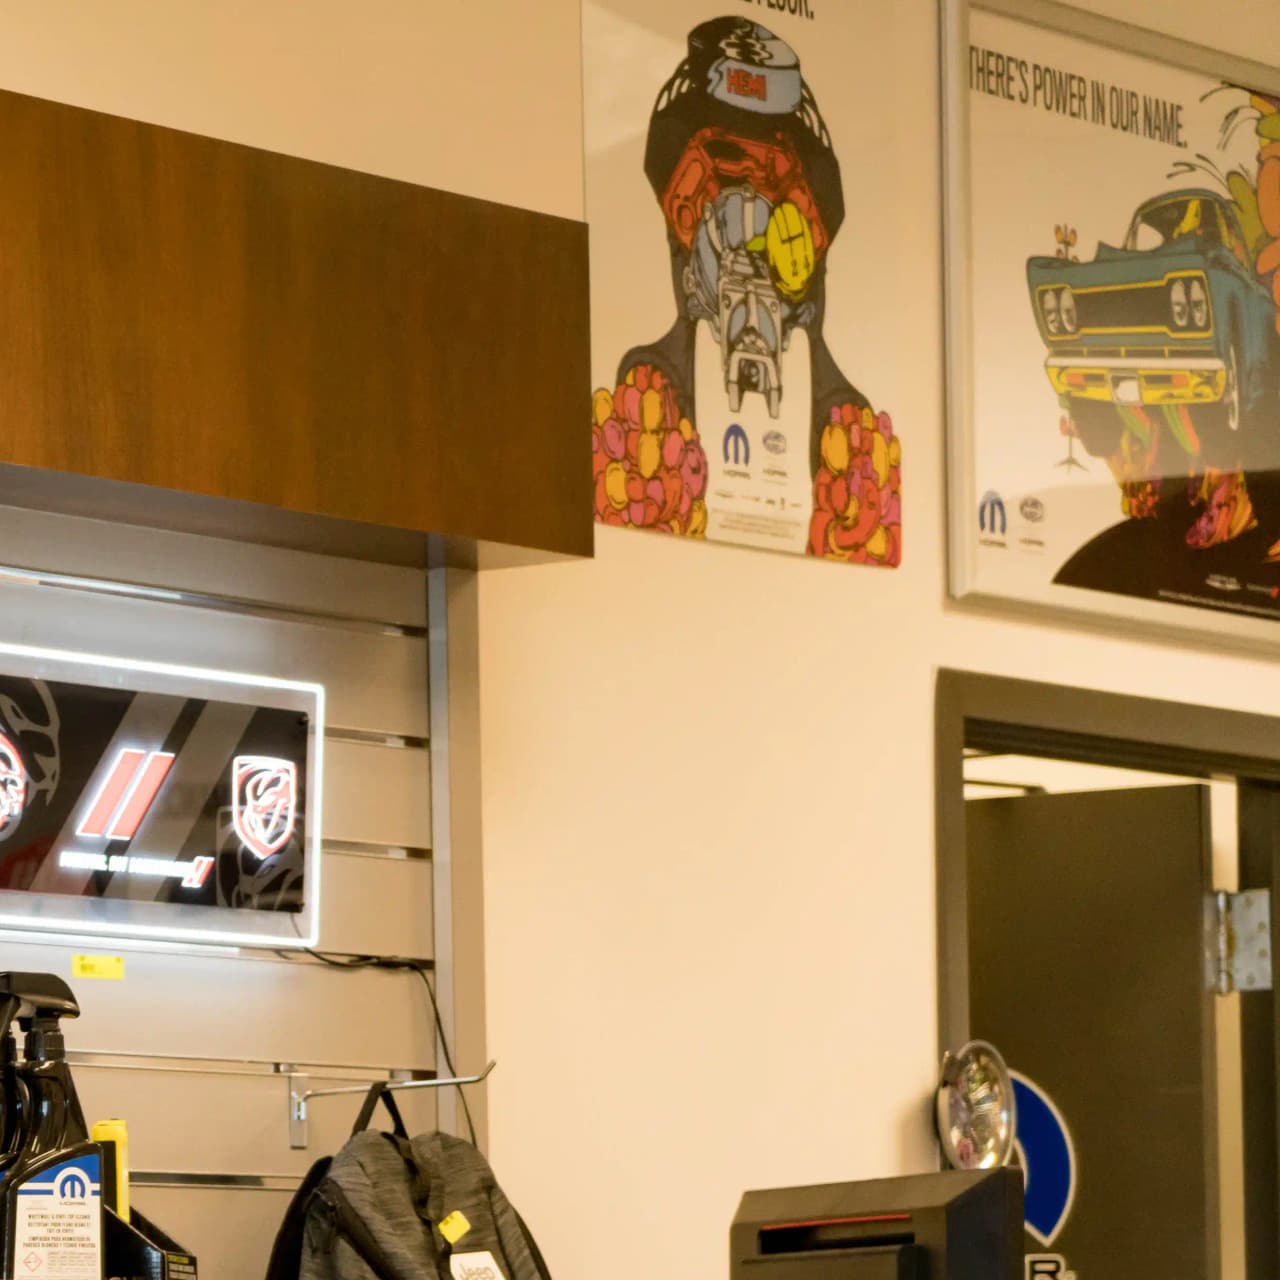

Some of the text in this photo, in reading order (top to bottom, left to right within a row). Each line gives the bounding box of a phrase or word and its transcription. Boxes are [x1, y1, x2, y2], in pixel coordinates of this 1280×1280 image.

[726, 67, 767, 101] HEMI
[969, 46, 1187, 148] THERE'S POWER IN OUR NAME.
